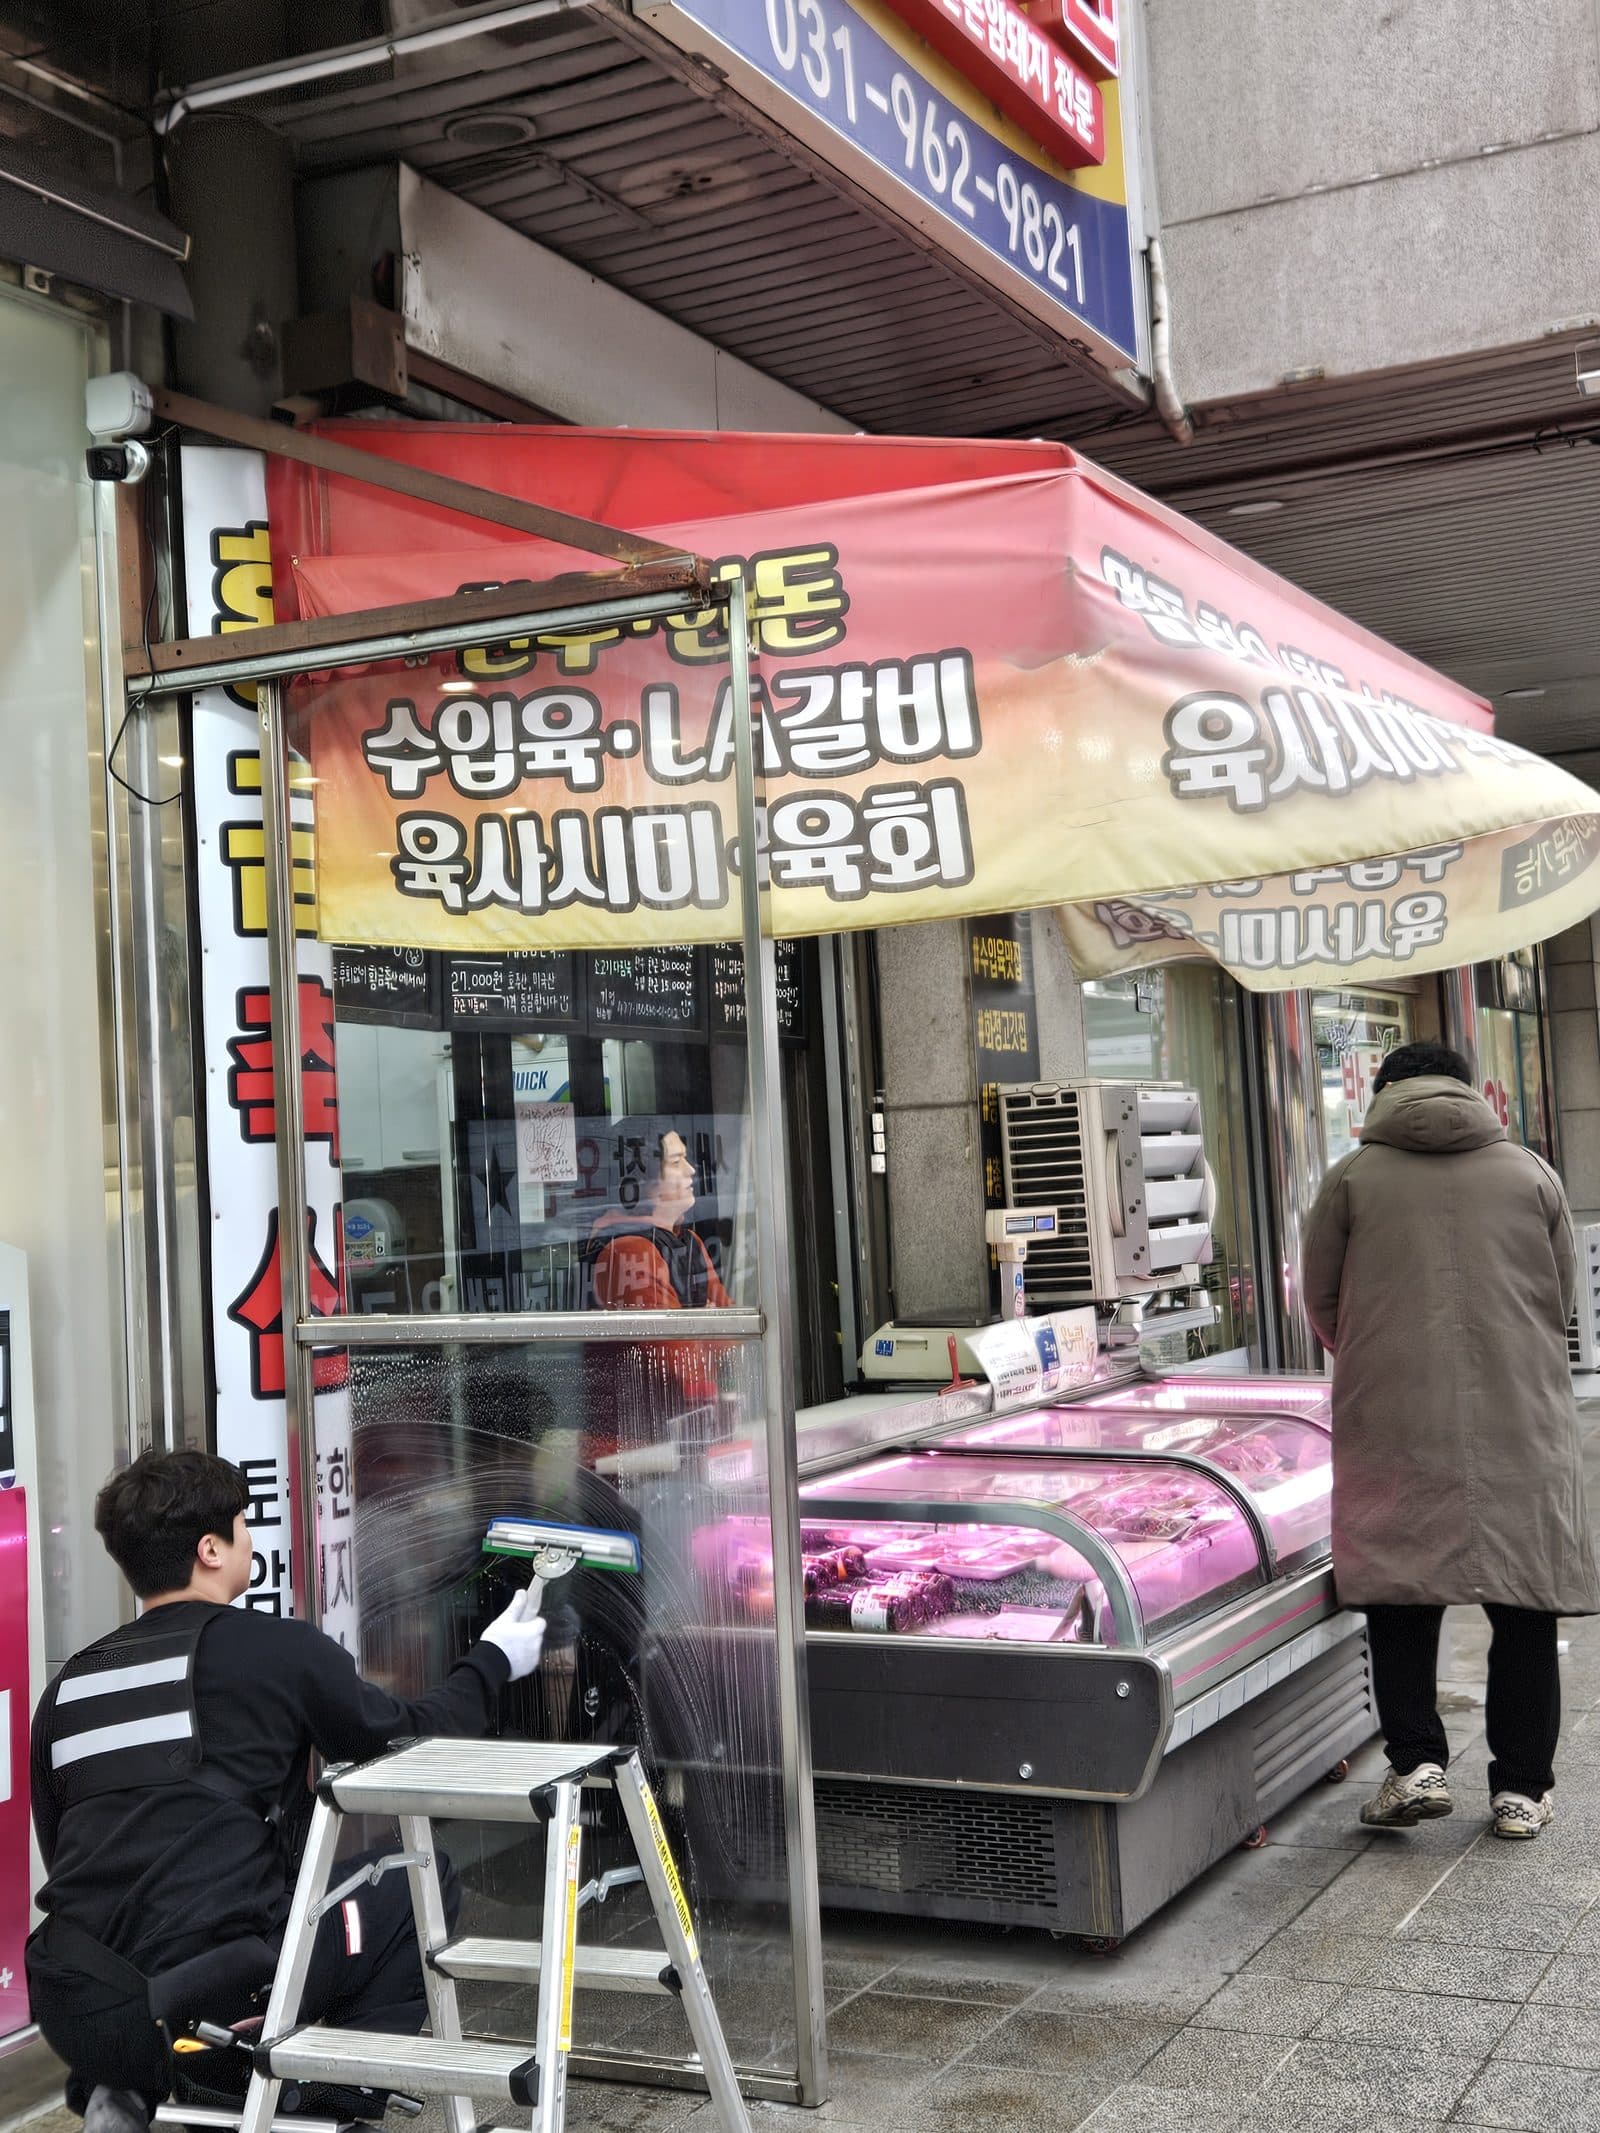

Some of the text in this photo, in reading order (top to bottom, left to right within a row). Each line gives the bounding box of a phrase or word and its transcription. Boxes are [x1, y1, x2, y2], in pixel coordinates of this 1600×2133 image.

[1053, 56, 1095, 145] 전문
[766, 0, 1084, 305] 031-962-9821
[361, 647, 983, 800] 수입육·LA갈비
[450, 970, 503, 993] 27.000원
[512, 1070, 549, 1091] UICK
